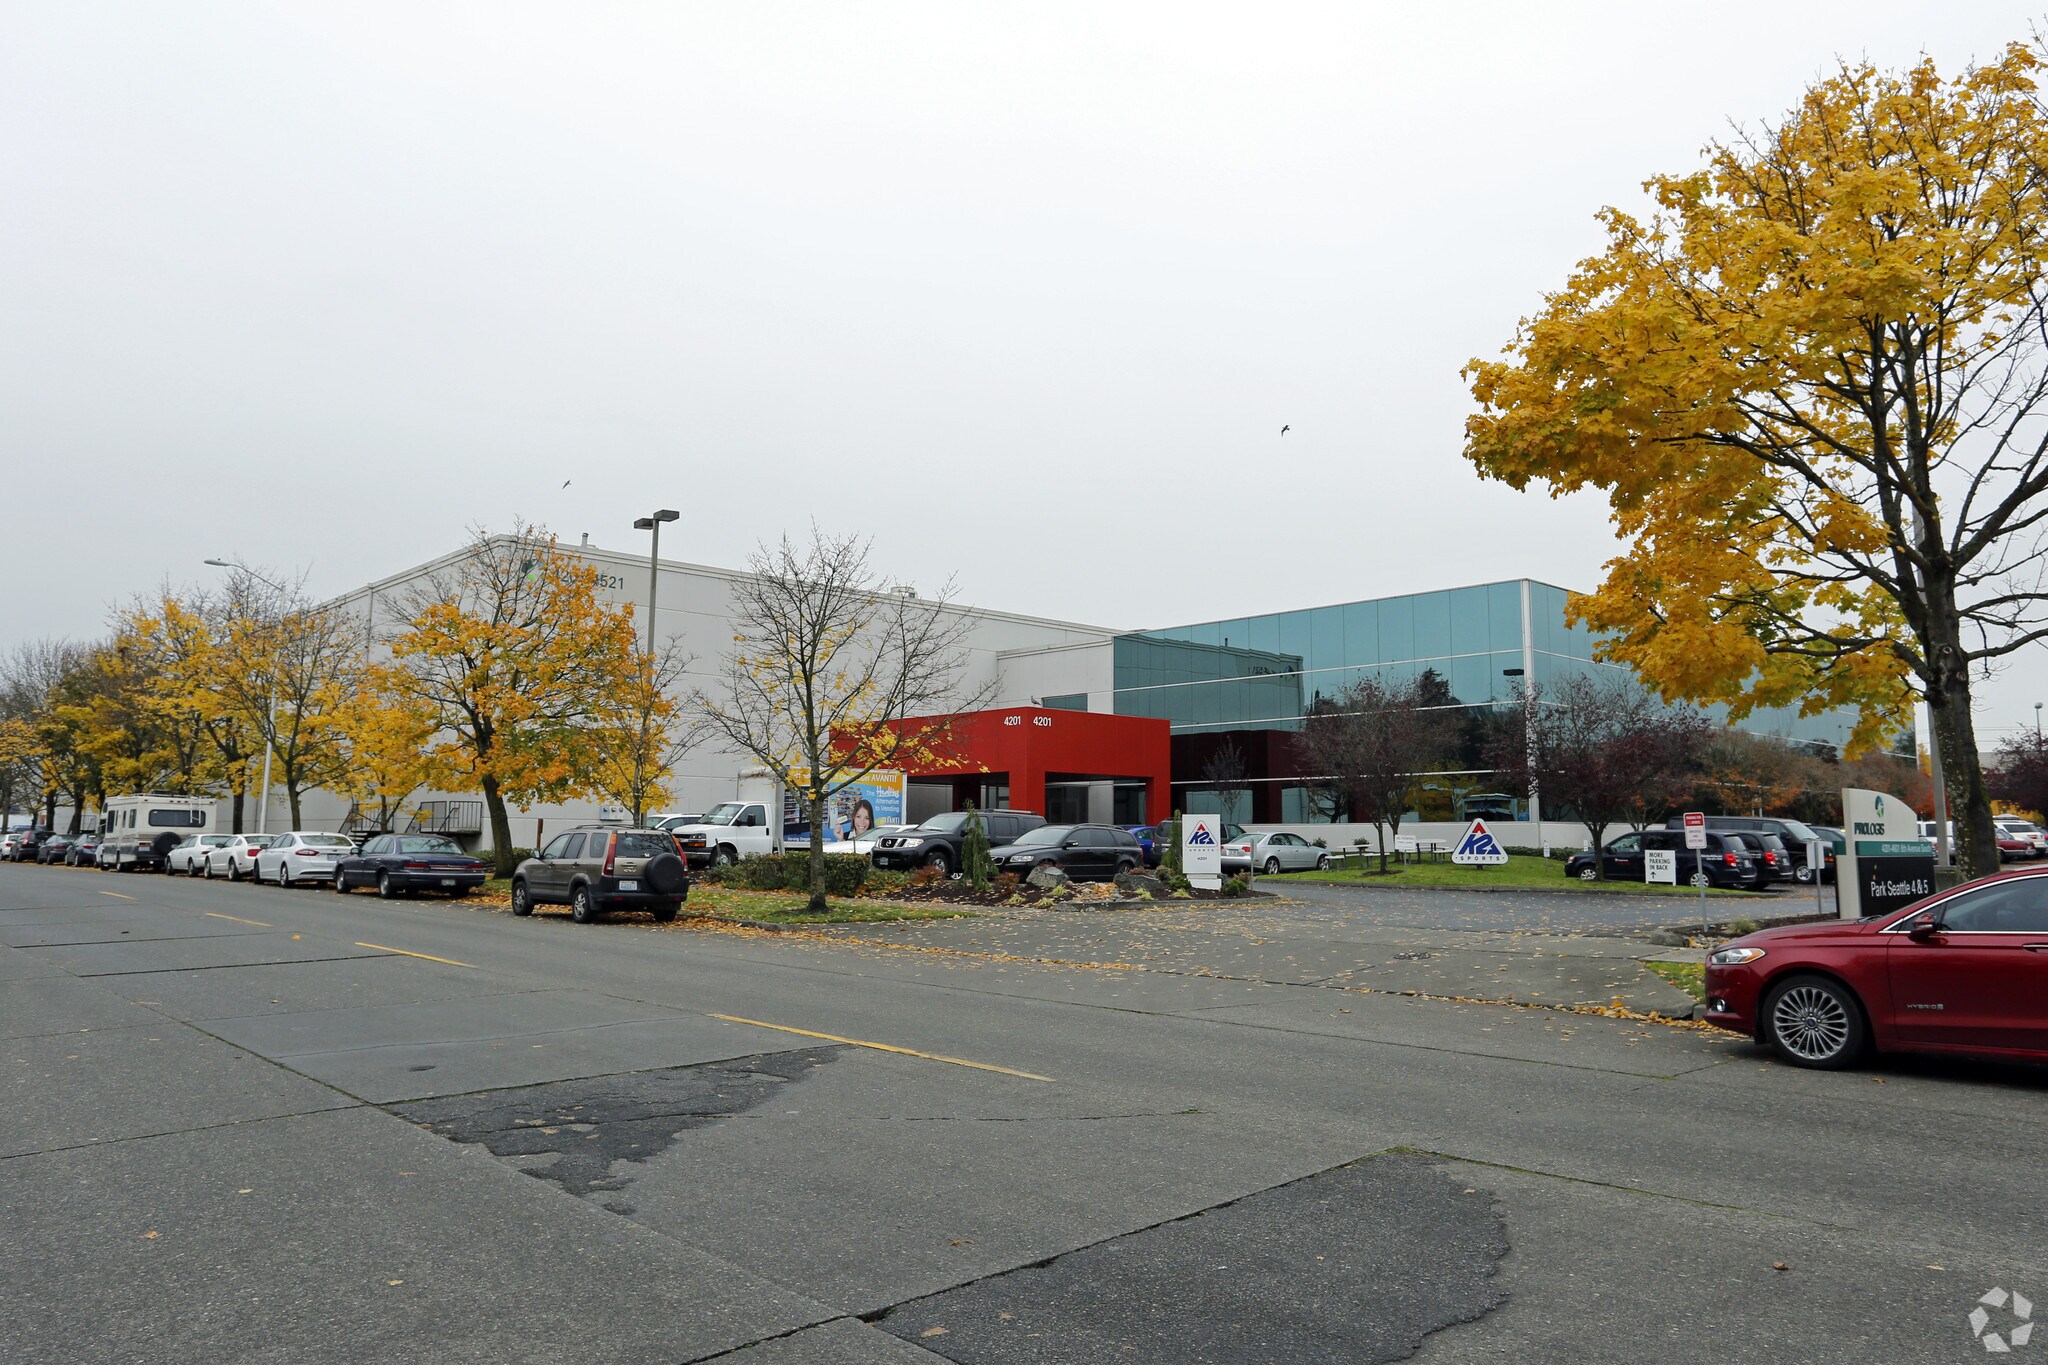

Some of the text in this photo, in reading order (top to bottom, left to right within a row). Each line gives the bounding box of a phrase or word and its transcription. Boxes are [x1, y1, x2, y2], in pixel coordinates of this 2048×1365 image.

[1003, 715, 1021, 726] 4201
[1033, 716, 1052, 727] 4201
[1189, 831, 1215, 844] K2
[1458, 834, 1501, 855] K2
[1870, 879, 1929, 897] Park Seattle 4 & 5
